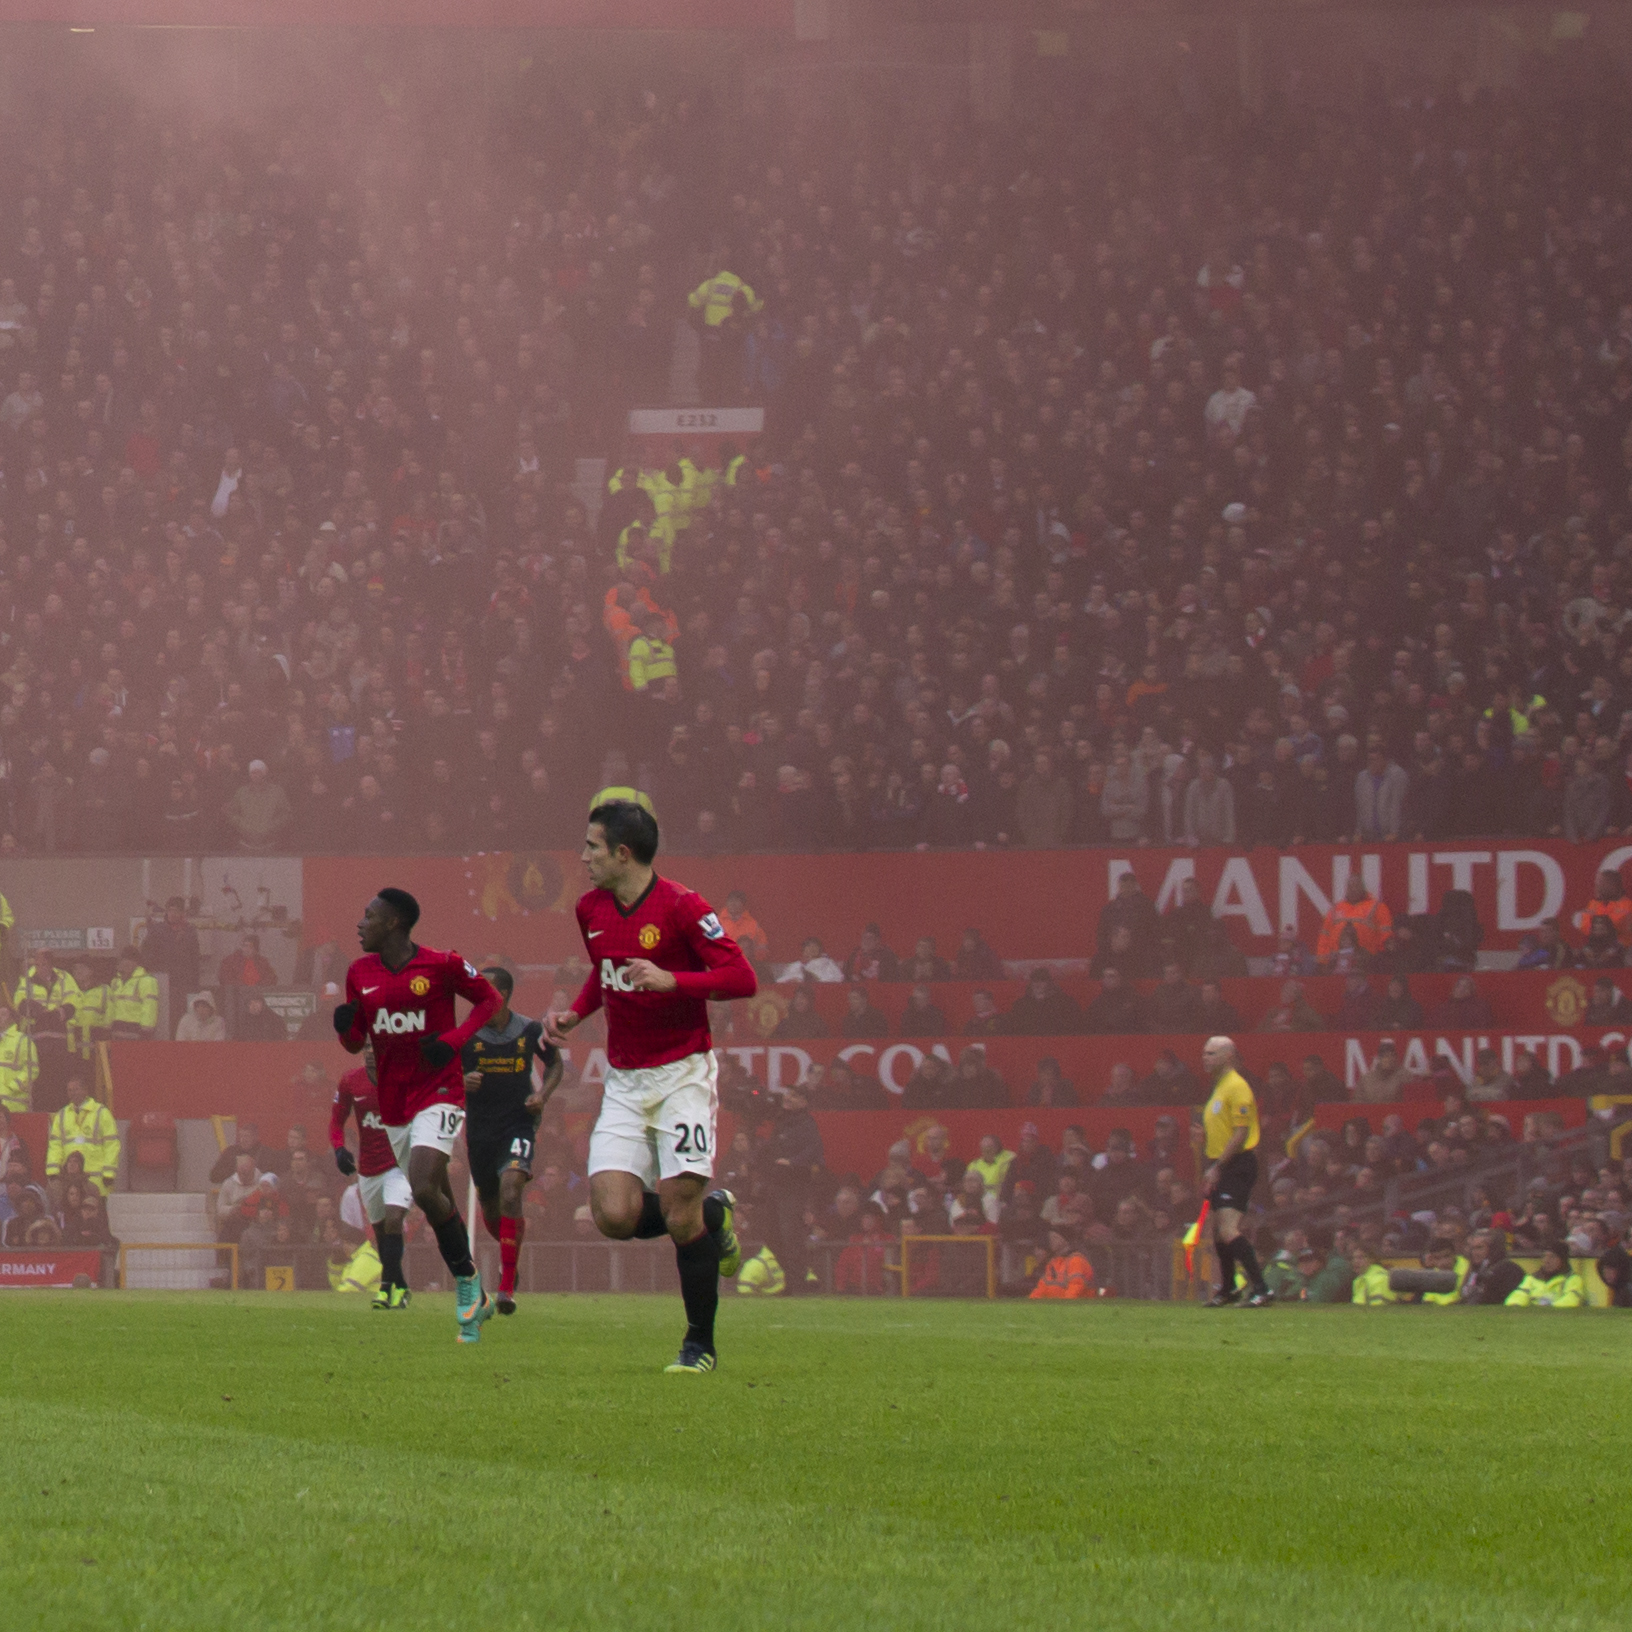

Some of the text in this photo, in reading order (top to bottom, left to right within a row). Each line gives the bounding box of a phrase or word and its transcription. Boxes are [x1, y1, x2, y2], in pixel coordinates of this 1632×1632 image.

[676, 414, 718, 428] E232
[372, 1008, 426, 1034] AON
[440, 1110, 456, 1135] 19
[510, 1137, 532, 1159] 47
[674, 1123, 707, 1154] 20
